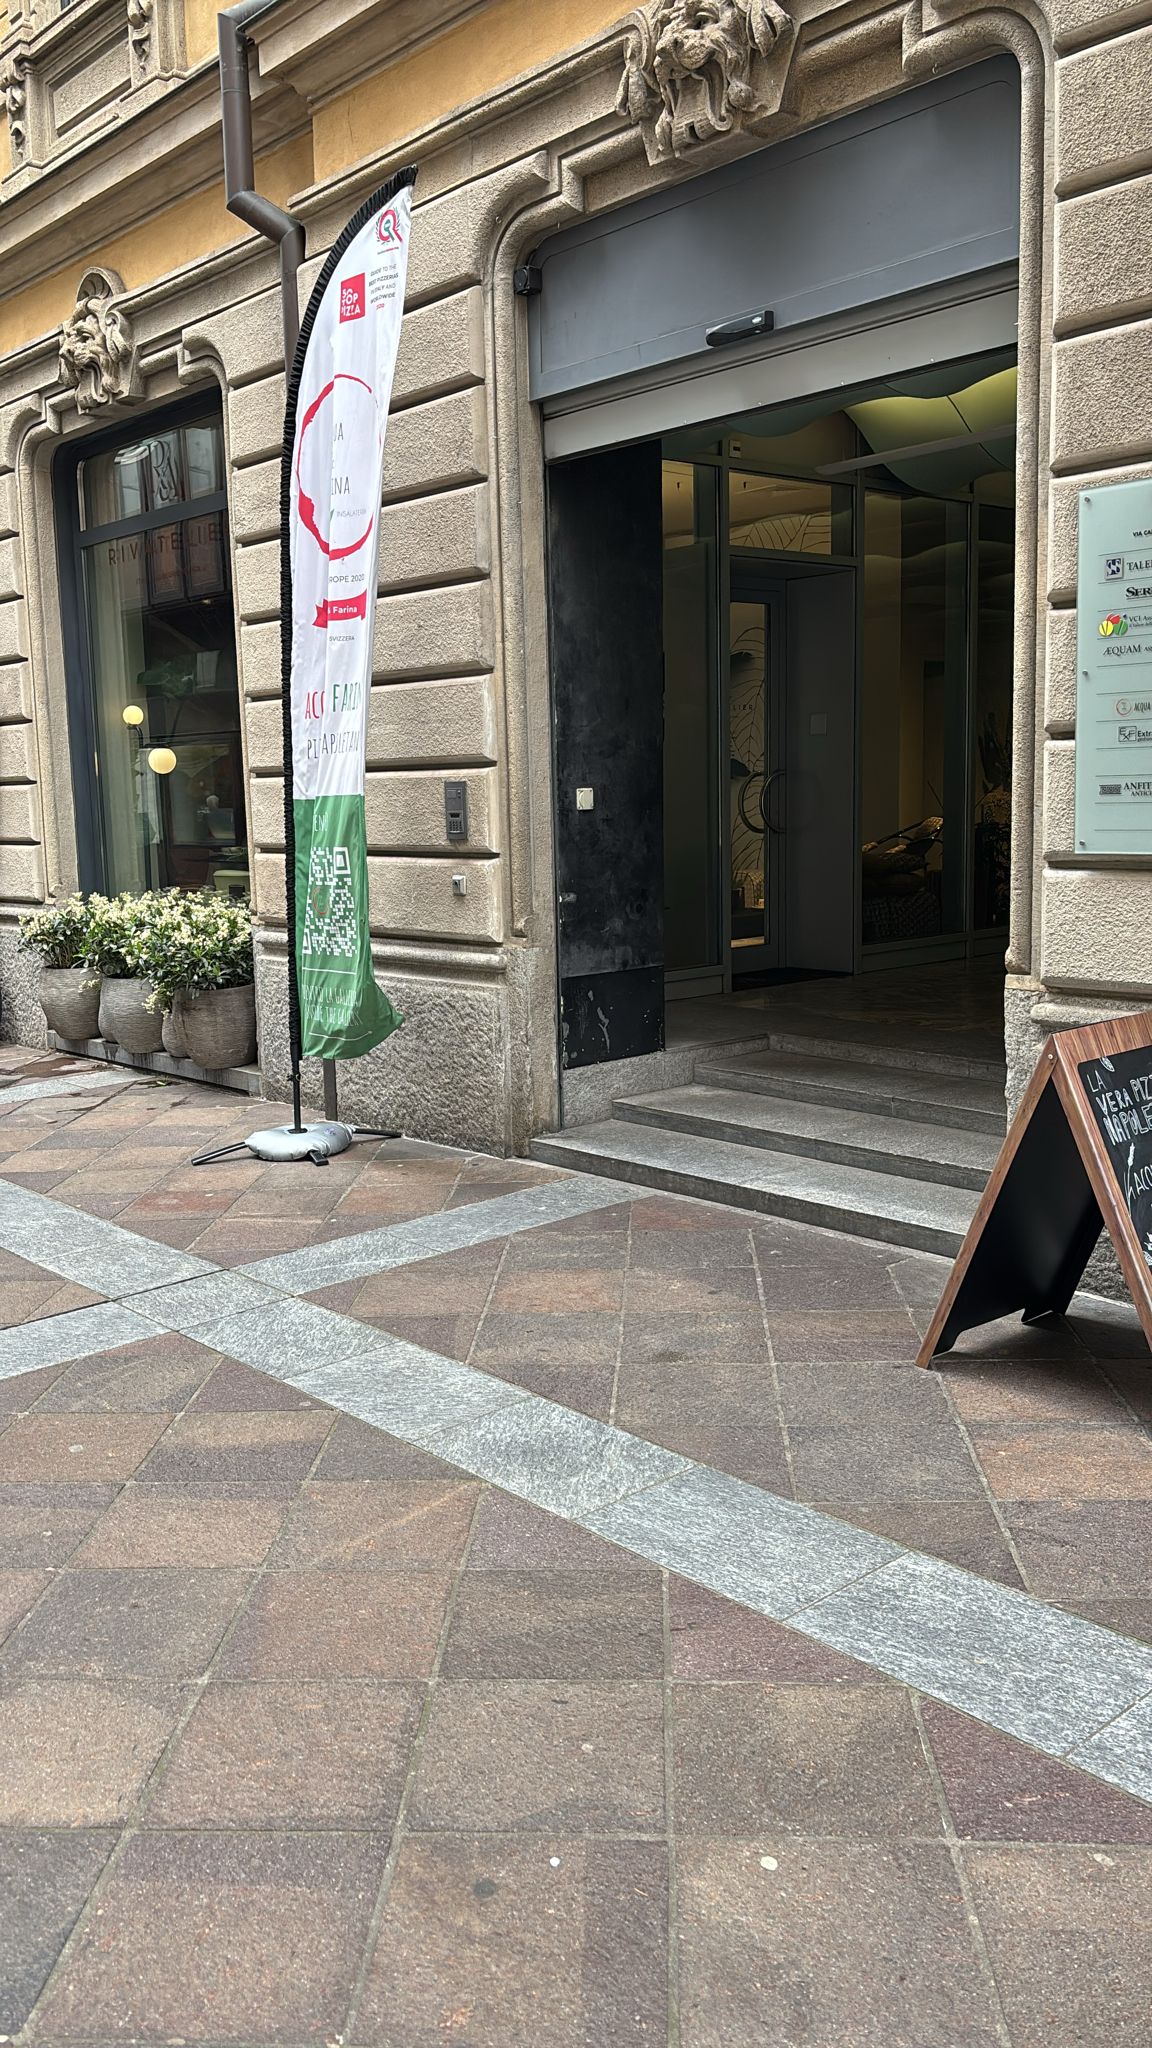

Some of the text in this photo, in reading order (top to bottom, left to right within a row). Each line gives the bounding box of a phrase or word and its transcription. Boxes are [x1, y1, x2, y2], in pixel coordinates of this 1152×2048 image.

[342, 292, 359, 306] TOP
[1133, 530, 1143, 538] VIA
[333, 604, 357, 614] Farina
[1103, 644, 1141, 657] ÆQUAM
[1134, 702, 1151, 714] ACQUA
[1086, 1069, 1107, 1093] LA
[1096, 1088, 1133, 1116] VERA
